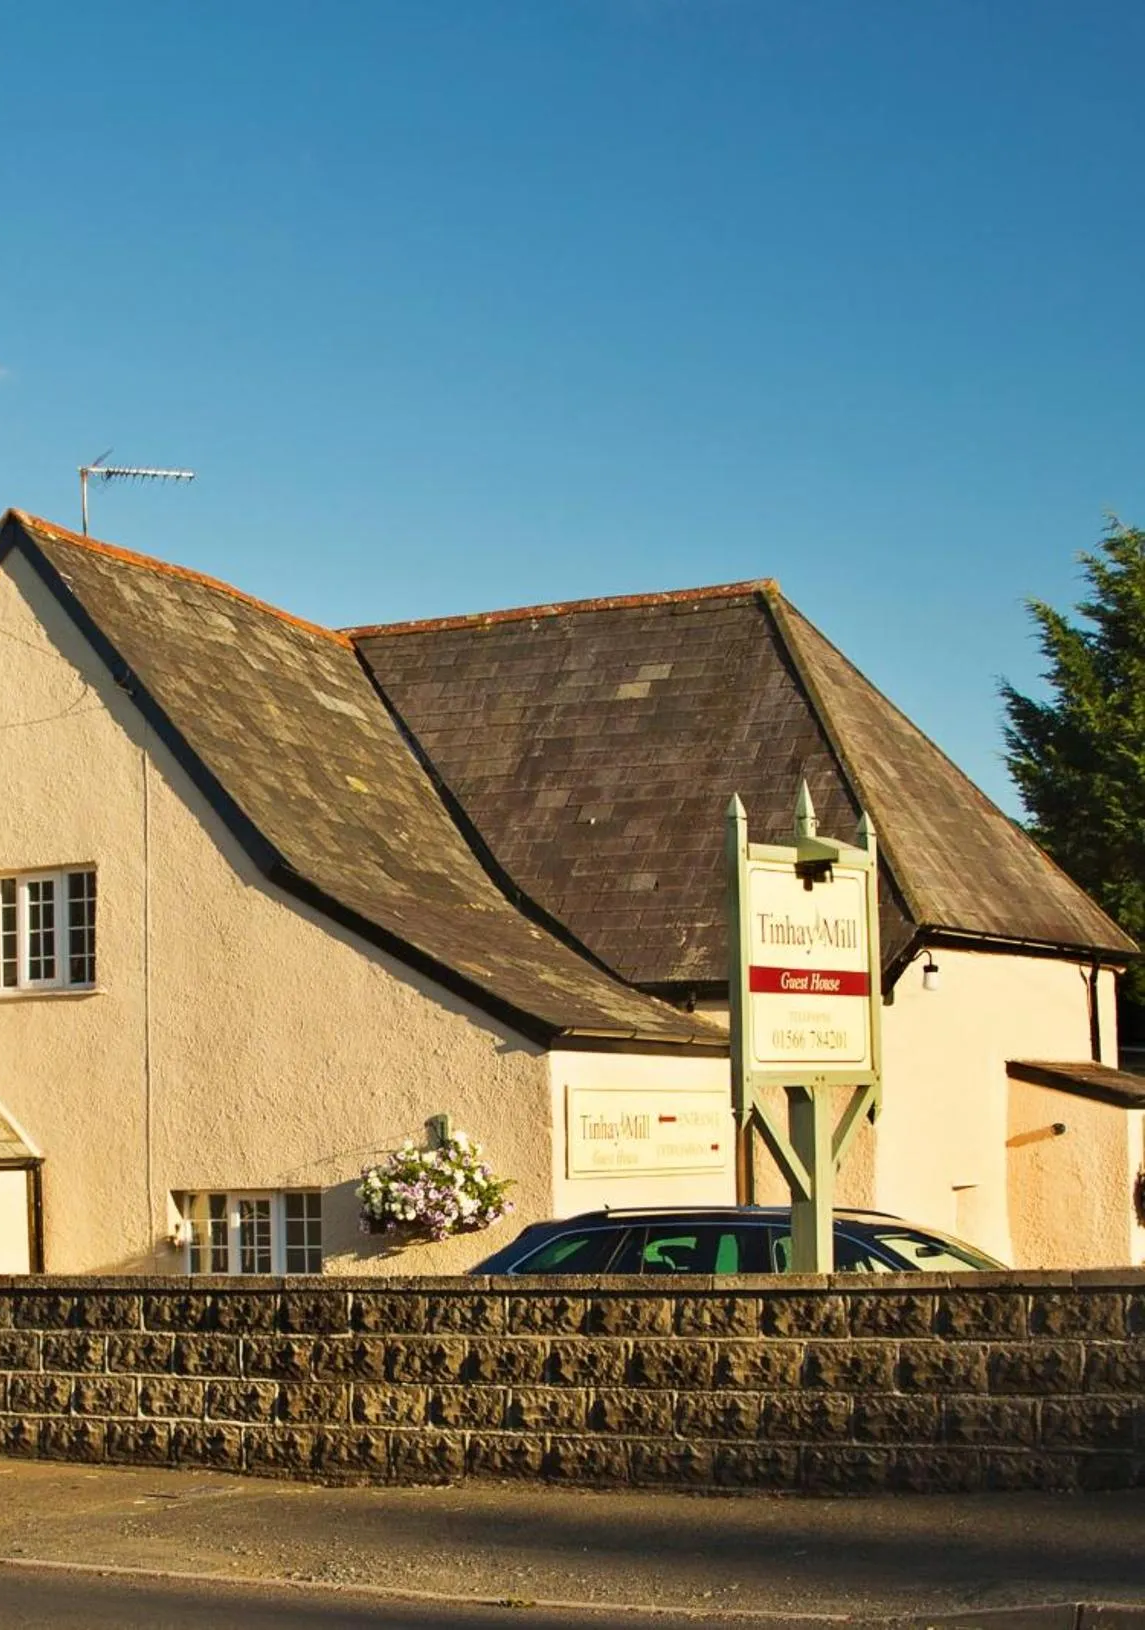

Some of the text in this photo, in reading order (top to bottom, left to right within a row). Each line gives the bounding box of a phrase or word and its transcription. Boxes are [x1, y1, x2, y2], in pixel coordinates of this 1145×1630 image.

[757, 912, 857, 954] Tinhay Mill
[781, 971, 840, 991] Guest House
[772, 1030, 805, 1049] 01566
[580, 1114, 618, 1145] Tinhay
[623, 1114, 649, 1137] Mill
